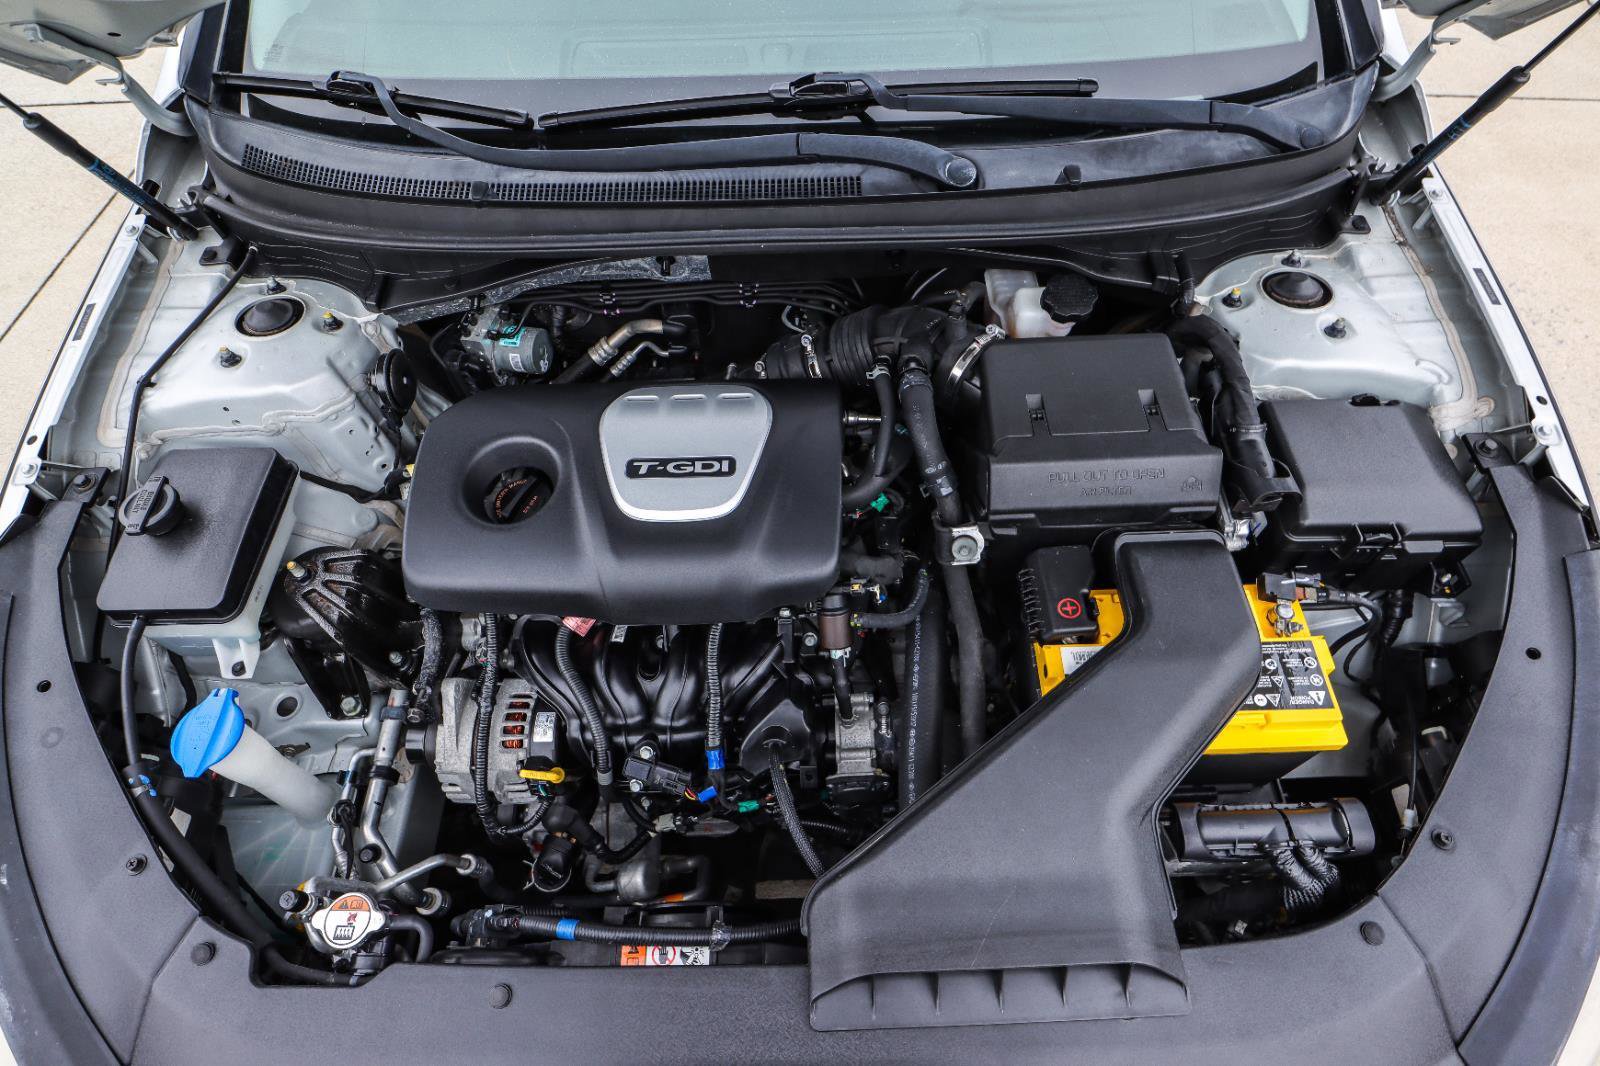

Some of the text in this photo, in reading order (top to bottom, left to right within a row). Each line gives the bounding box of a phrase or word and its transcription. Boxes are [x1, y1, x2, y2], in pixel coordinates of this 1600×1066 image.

[633, 460, 729, 475] T-GDI
[1048, 467, 1165, 483] PULL OUT TO OPEN
